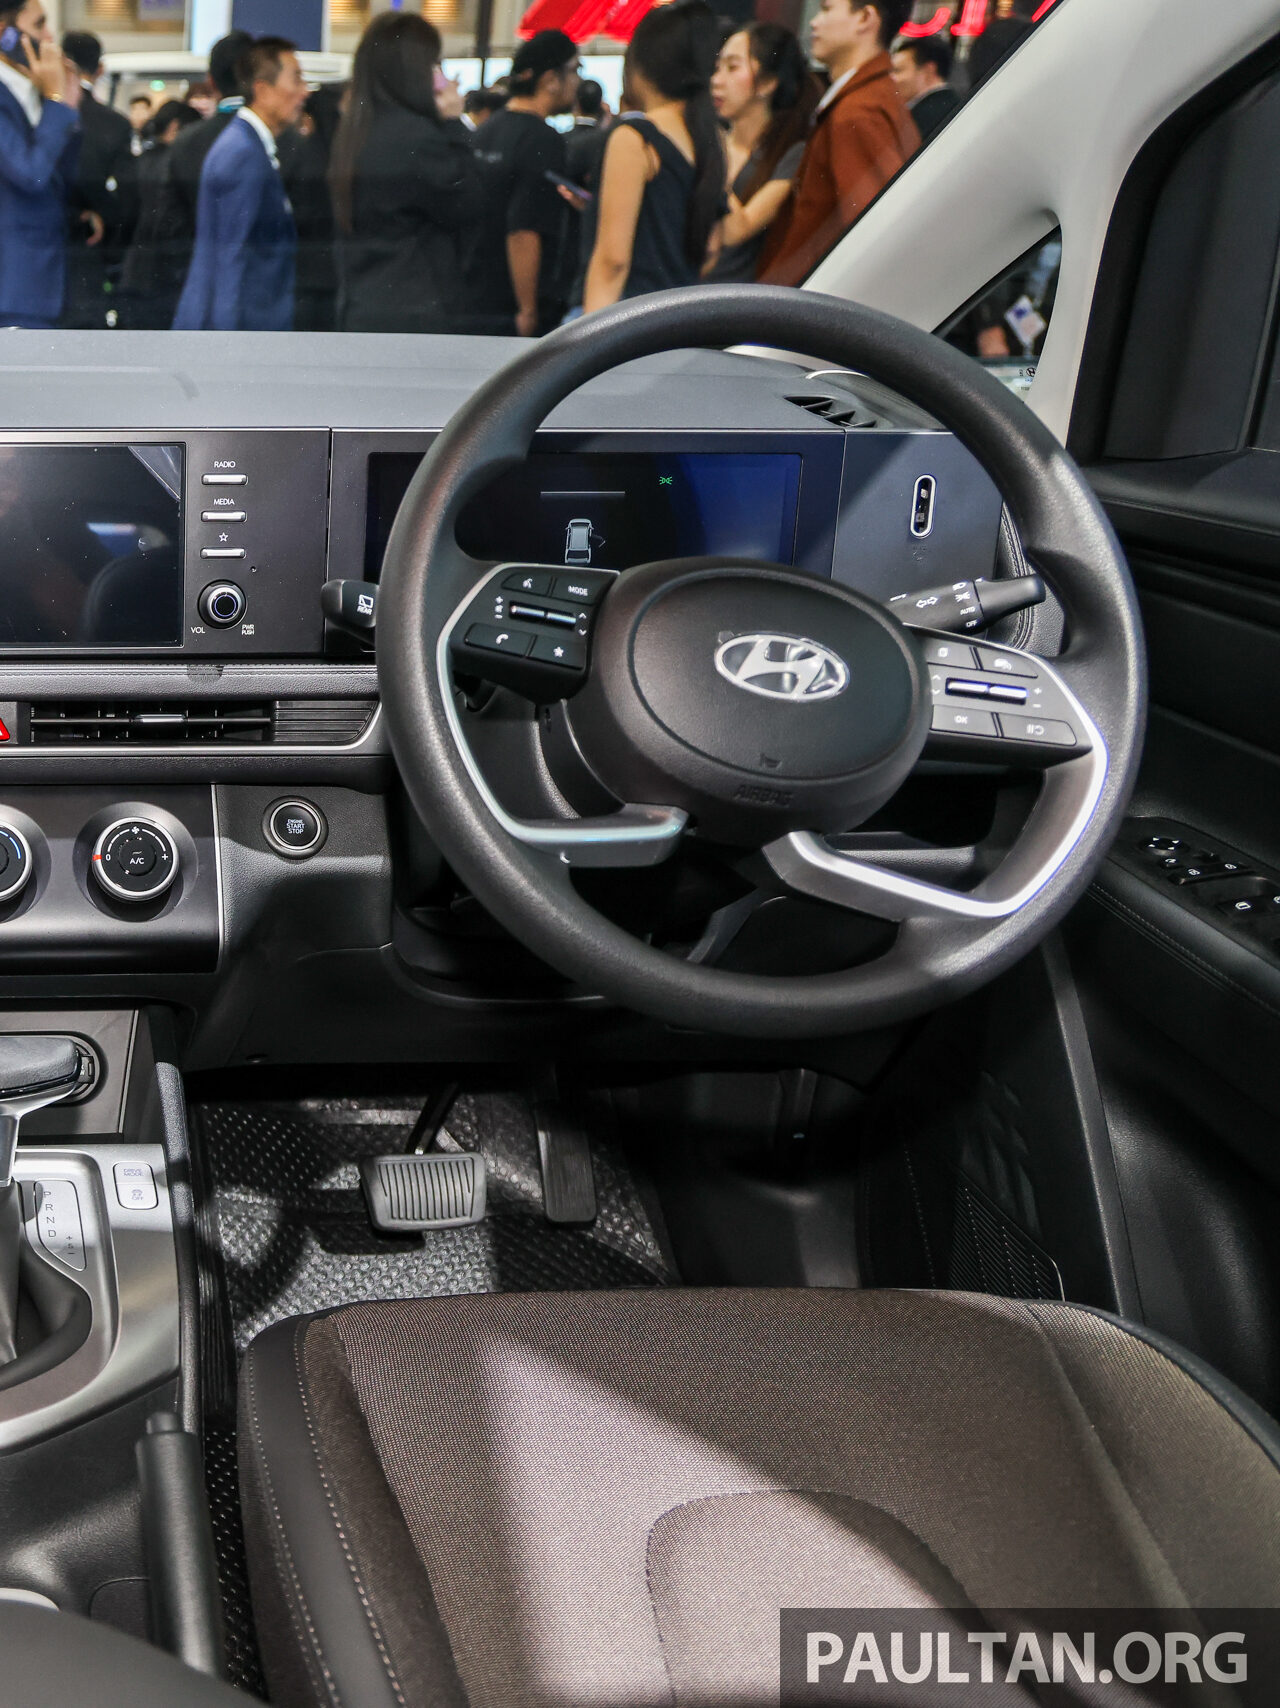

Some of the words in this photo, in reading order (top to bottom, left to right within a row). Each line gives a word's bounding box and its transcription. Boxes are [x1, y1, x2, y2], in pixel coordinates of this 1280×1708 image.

[213, 460, 236, 468] RADIO
[213, 498, 235, 506] MEDIA
[567, 585, 588, 597] MODE
[960, 606, 976, 615] AUTO
[965, 619, 978, 628] OFF
[190, 626, 206, 634] VOL
[954, 714, 968, 724] OK
[129, 857, 145, 865] A/C
[45, 1203, 54, 1211] R
[46, 1216, 55, 1224] N
[48, 1229, 57, 1238] D
